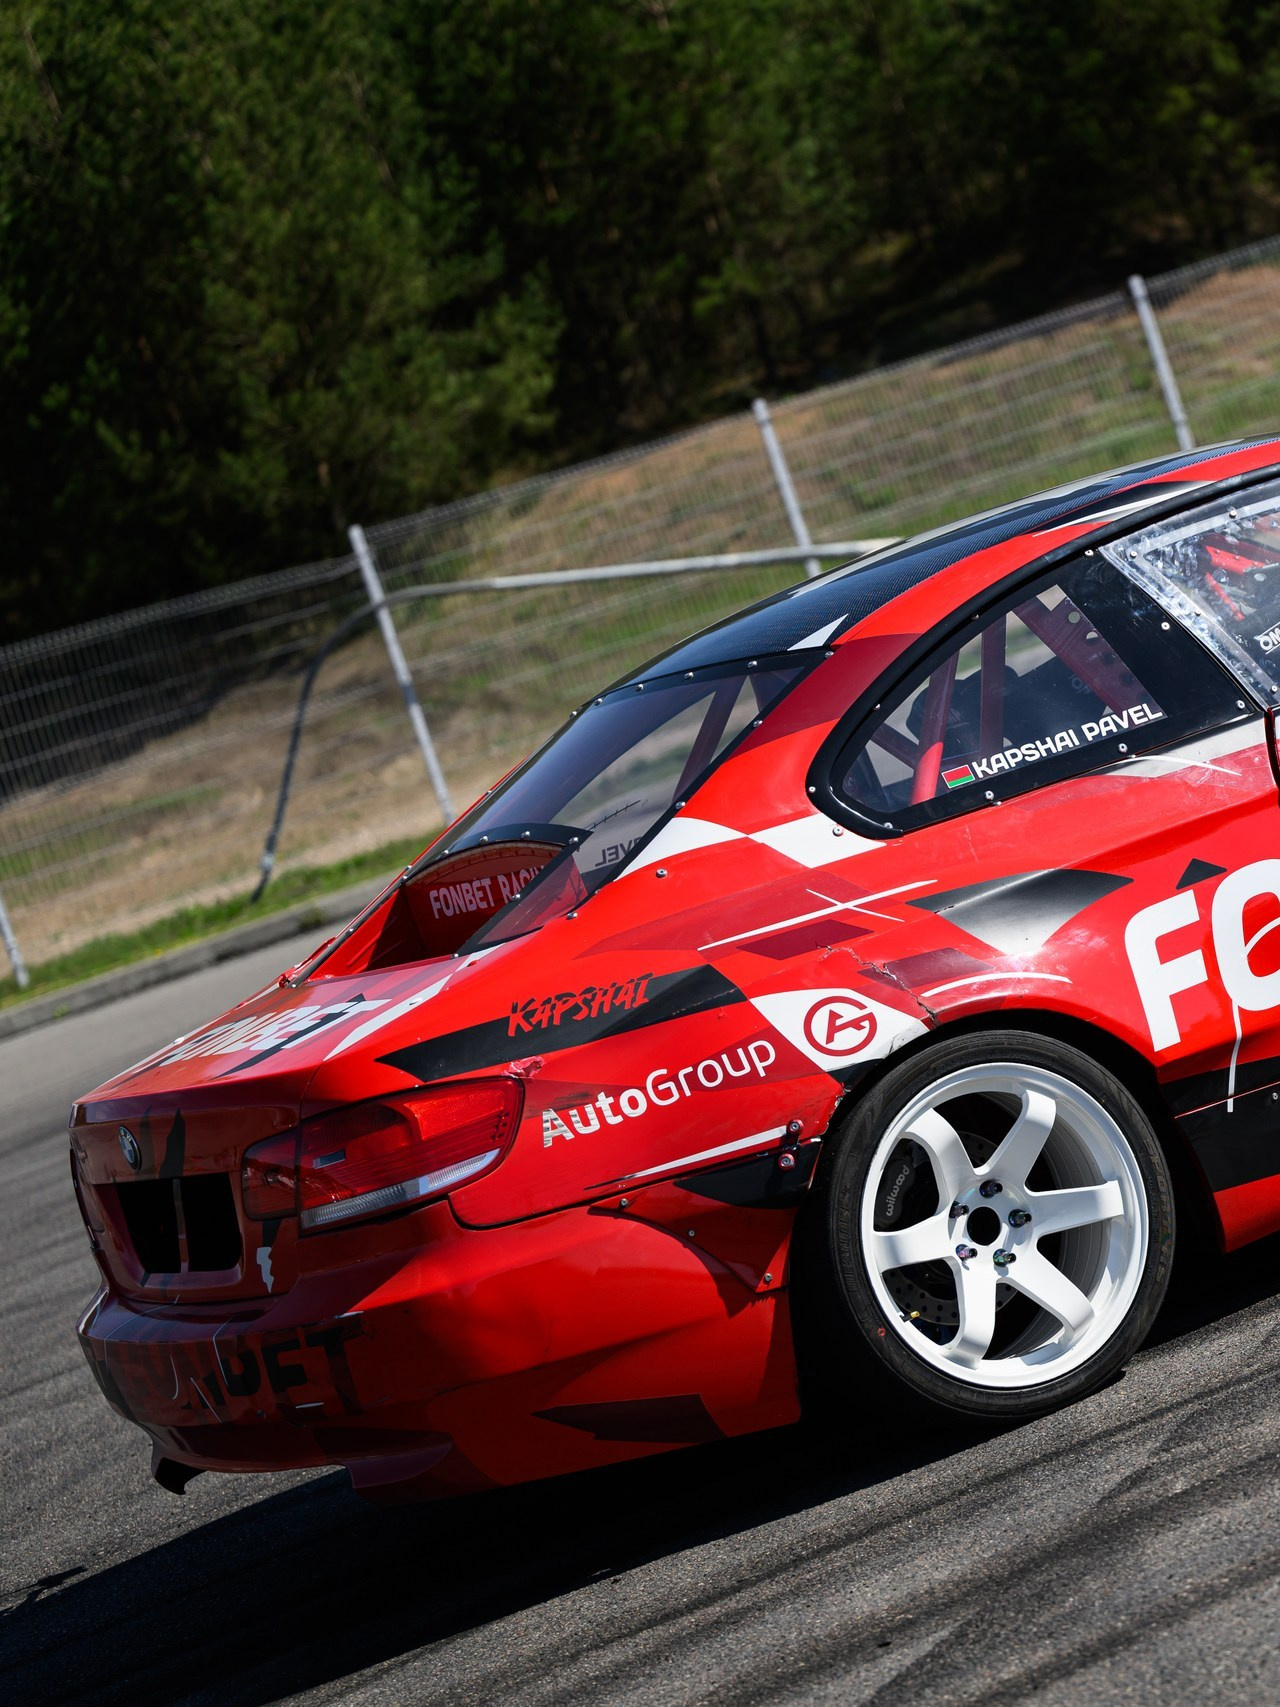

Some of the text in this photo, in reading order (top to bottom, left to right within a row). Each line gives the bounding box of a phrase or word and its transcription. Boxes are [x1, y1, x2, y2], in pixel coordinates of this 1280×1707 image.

[971, 703, 1163, 778] KAPSHAI PAVEL
[429, 878, 495, 919] FONBET
[508, 972, 653, 1036] KAPSHAI
[542, 1039, 776, 1148] AutoGroup
[885, 1164, 910, 1217] wilwood
